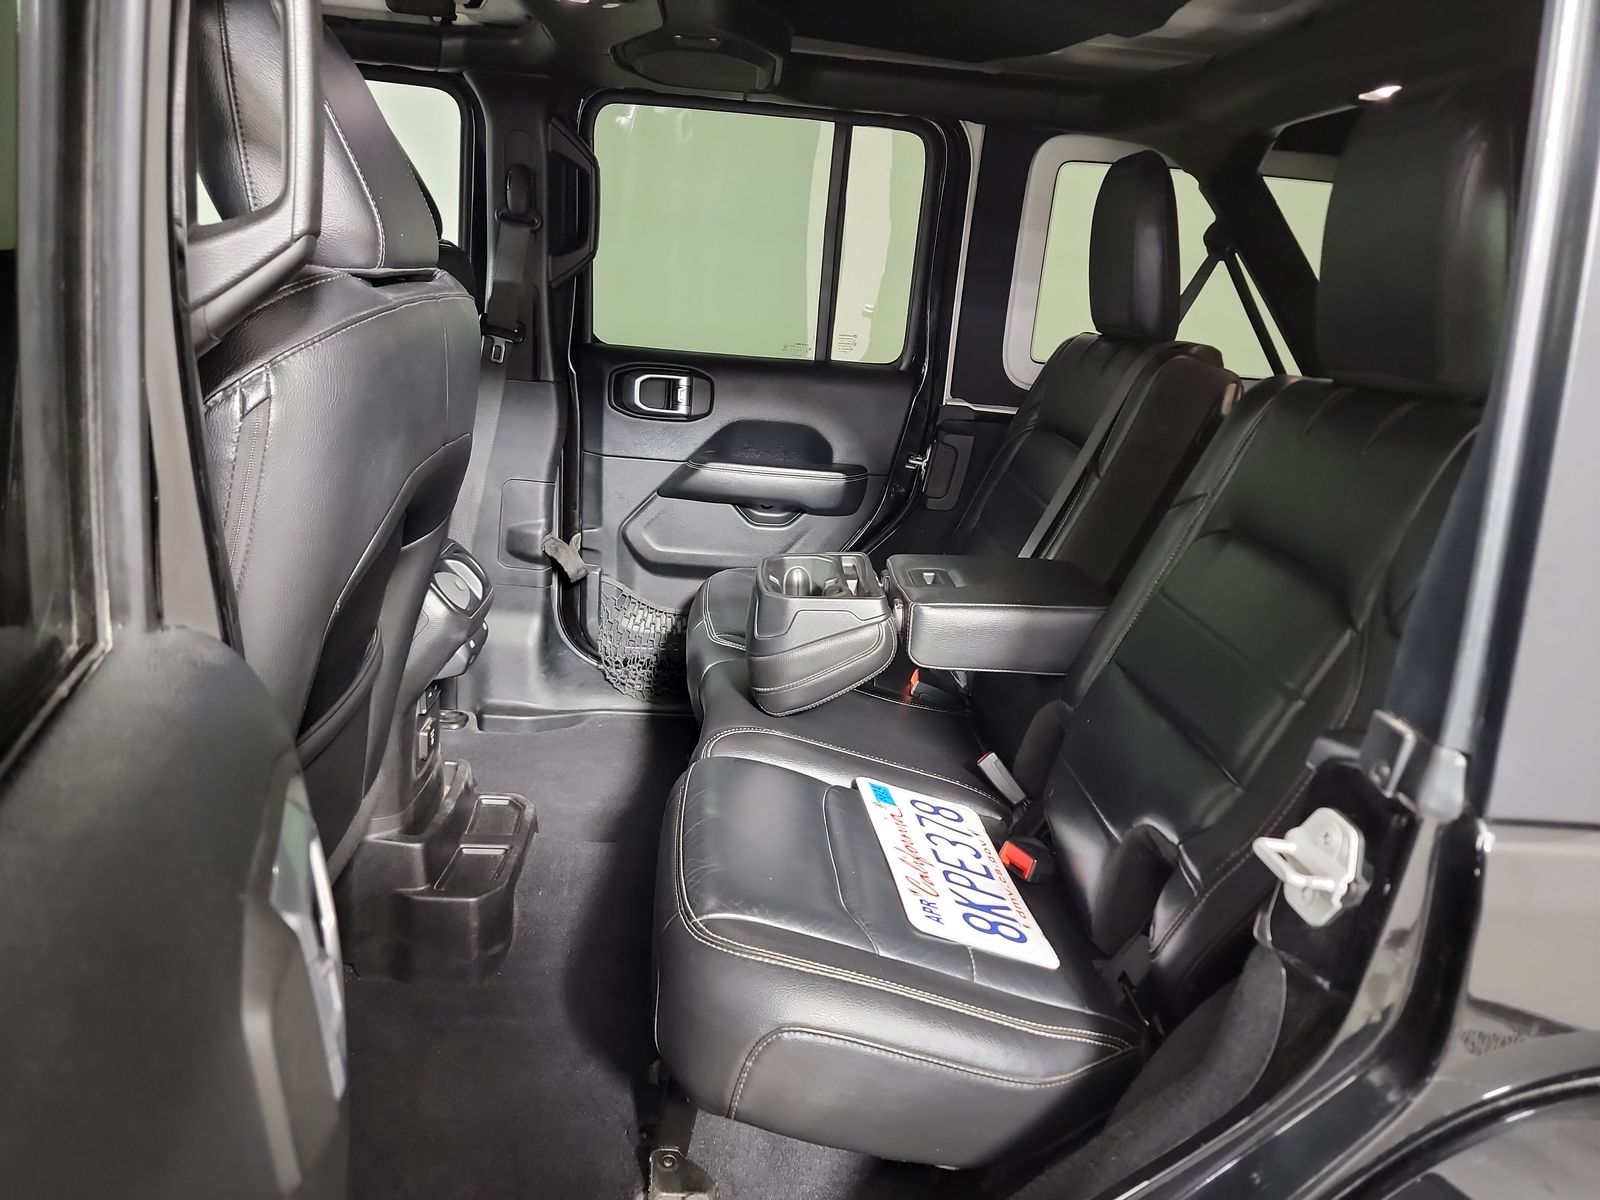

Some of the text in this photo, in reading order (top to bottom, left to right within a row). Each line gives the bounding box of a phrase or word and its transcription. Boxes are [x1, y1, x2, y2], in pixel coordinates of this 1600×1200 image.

[885, 807, 940, 898] California
[909, 798, 1028, 944] 8KPE378
[979, 837, 1028, 920] dmv.ca.gov
[919, 898, 943, 925] APR
